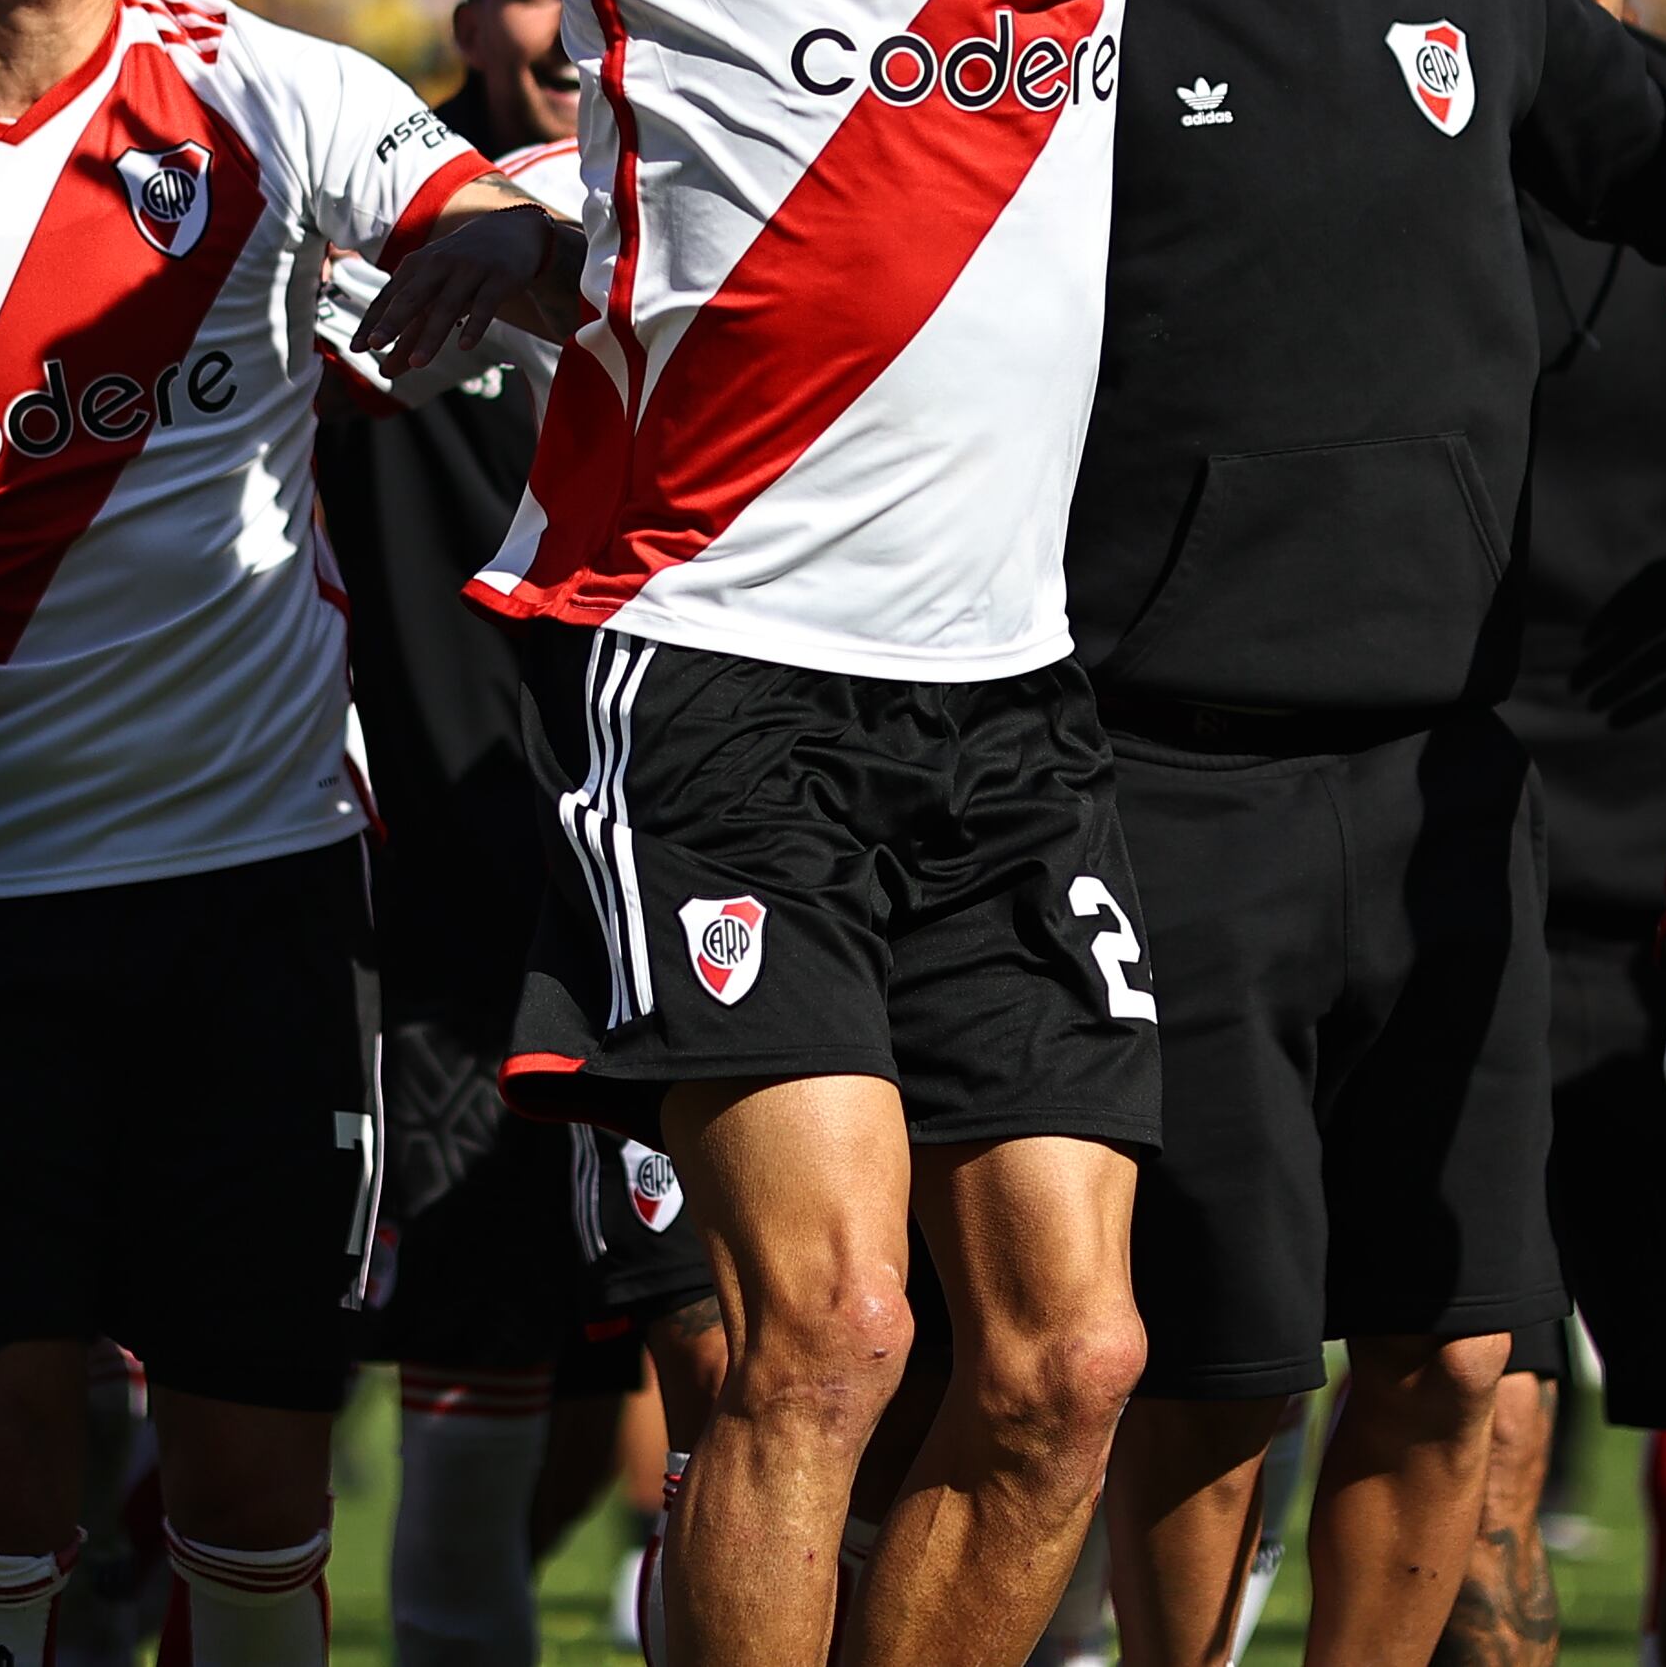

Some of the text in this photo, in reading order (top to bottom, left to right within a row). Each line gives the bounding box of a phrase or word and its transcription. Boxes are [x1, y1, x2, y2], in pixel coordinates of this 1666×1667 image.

[791, 12, 1116, 108] codere
[1416, 45, 1460, 94] CARP
[1181, 110, 1234, 127] adidas
[142, 169, 197, 220] CARP
[702, 919, 751, 965] CARP
[1068, 876, 1158, 1022] 2
[334, 1111, 374, 1256] 7
